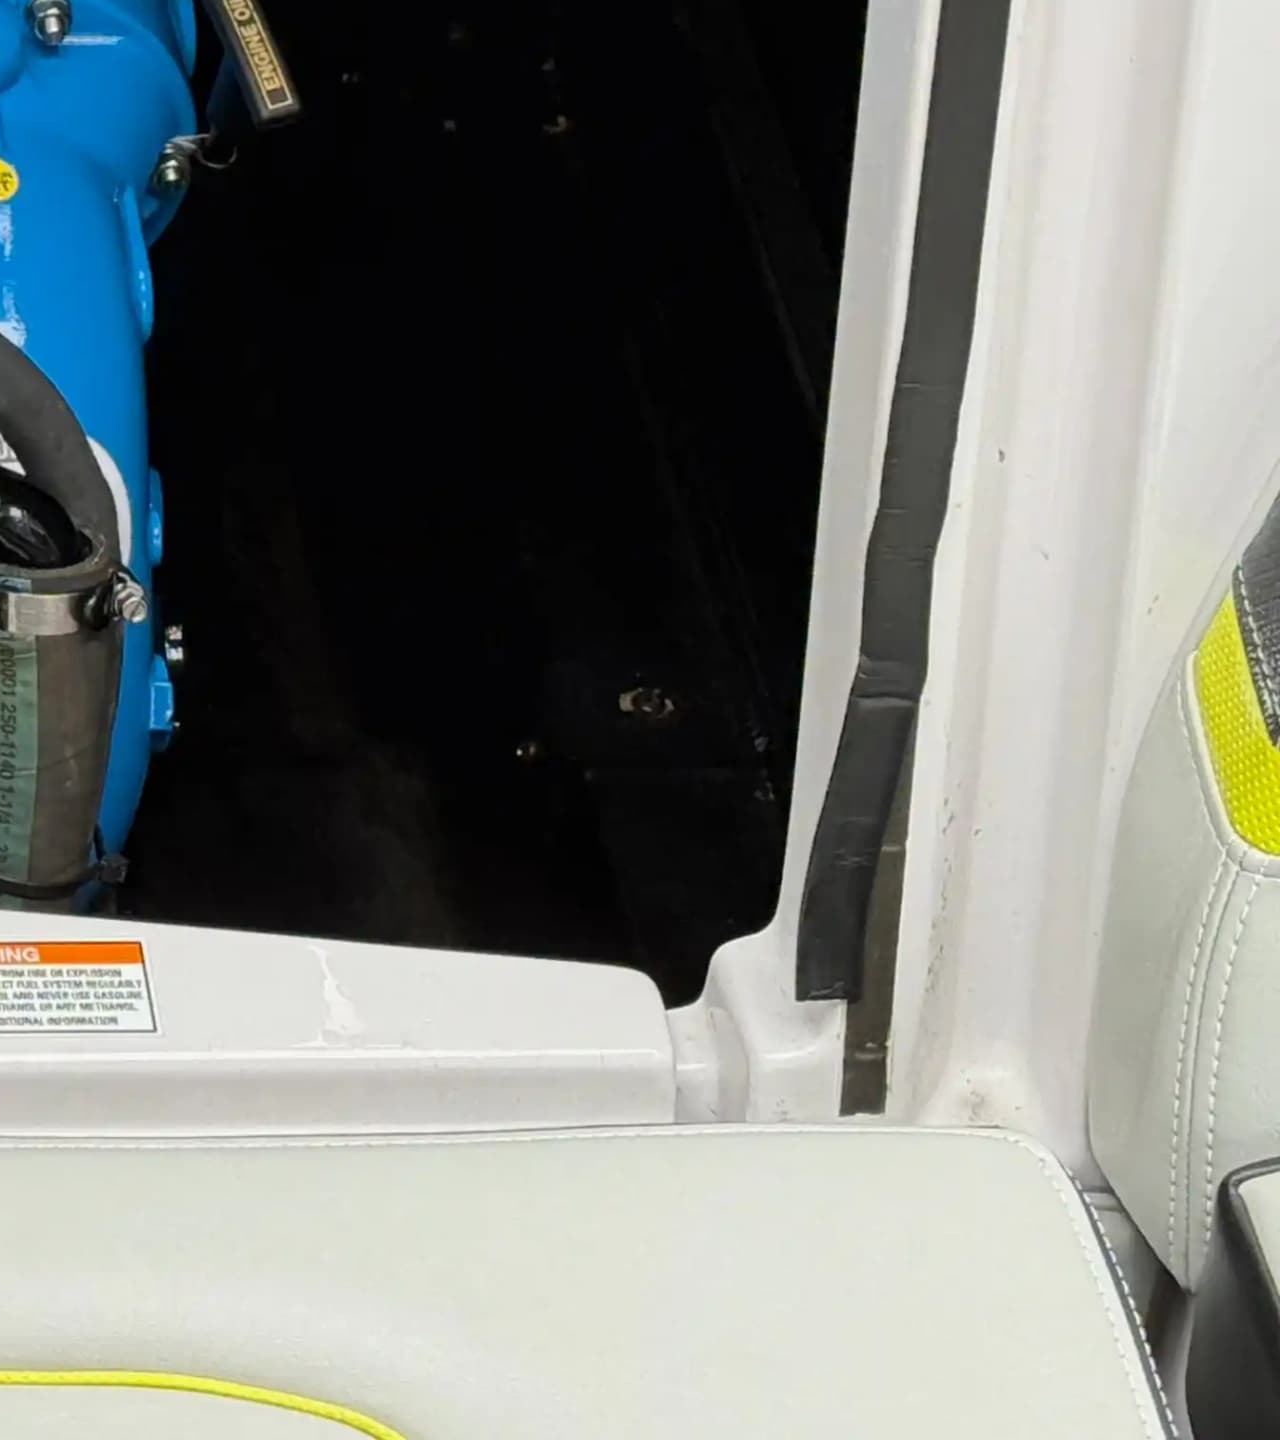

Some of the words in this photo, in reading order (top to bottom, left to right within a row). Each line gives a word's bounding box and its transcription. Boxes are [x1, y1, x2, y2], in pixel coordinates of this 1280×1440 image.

[240, 23, 280, 91] ENGINE
[42, 980, 83, 989] SYSTEM
[37, 992, 68, 1000] NEVER
